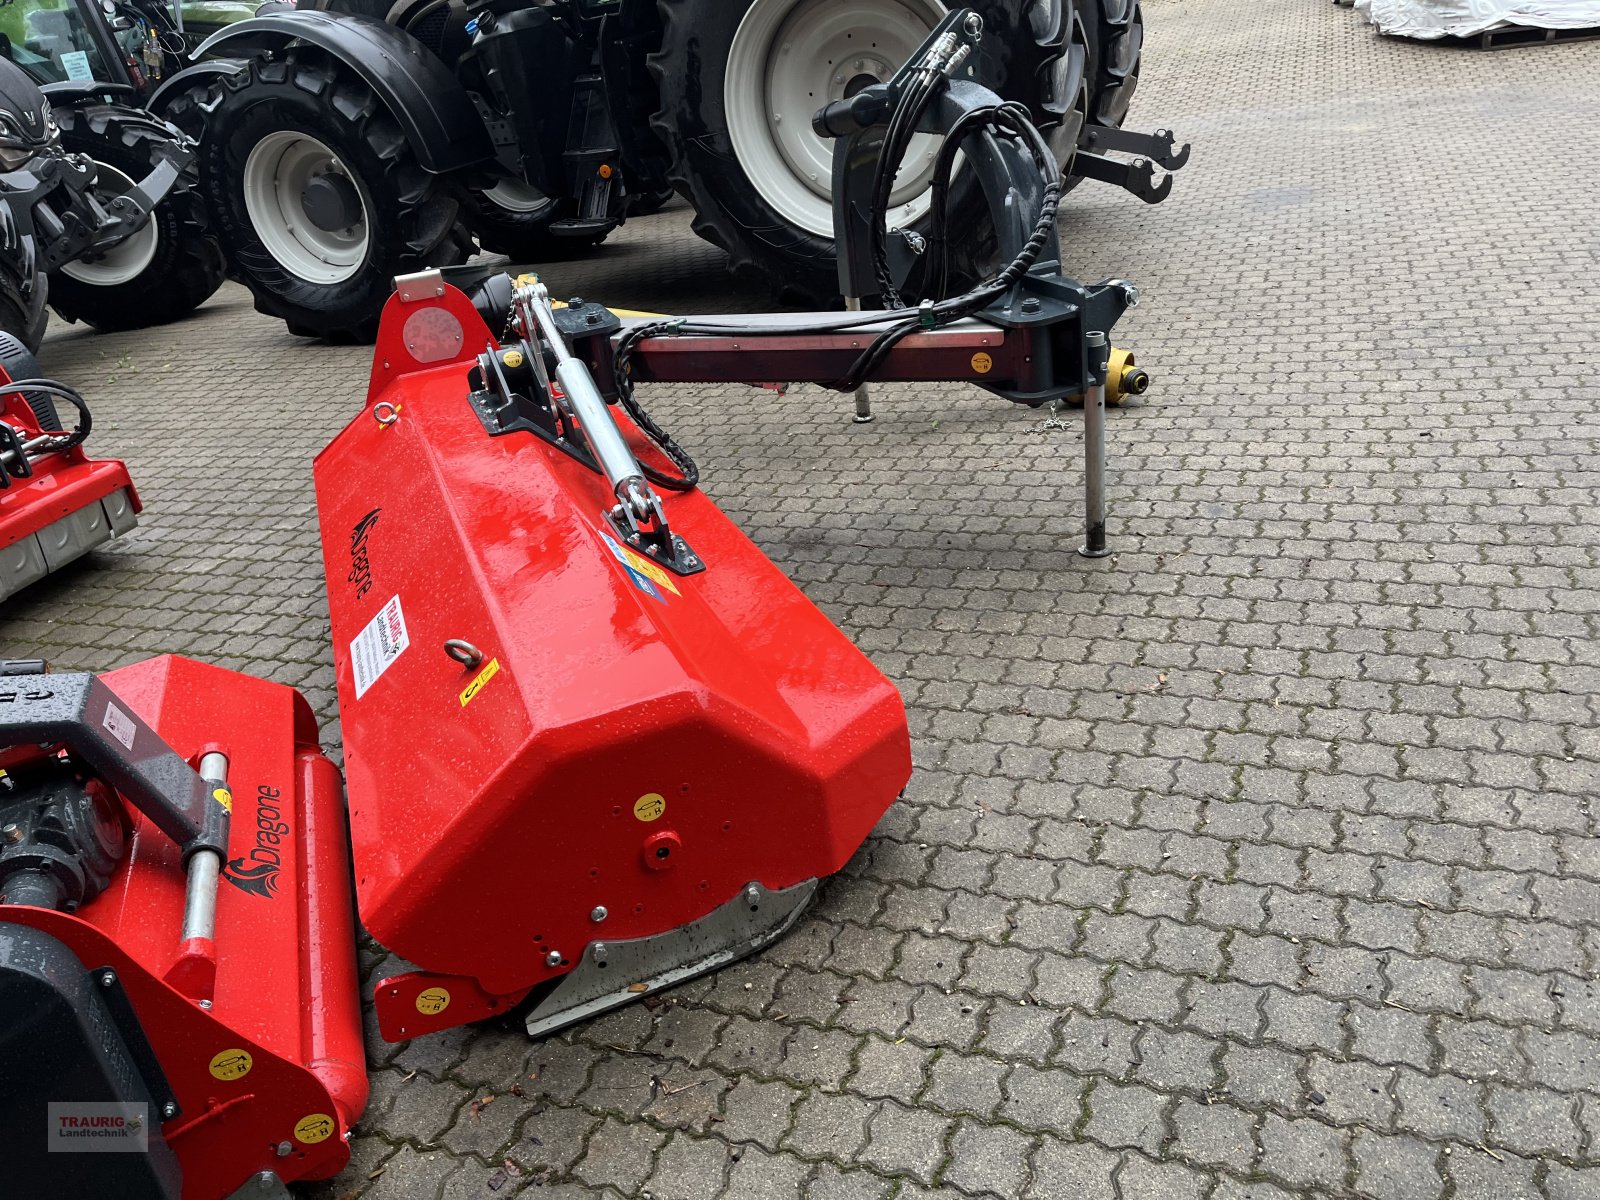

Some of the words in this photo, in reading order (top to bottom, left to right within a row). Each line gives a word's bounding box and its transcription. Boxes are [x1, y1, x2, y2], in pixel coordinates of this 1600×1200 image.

[348, 534, 373, 600] Dragone
[376, 610, 391, 656] Landtechnik
[386, 600, 402, 643] TRAURIG
[250, 785, 289, 867] Dragone
